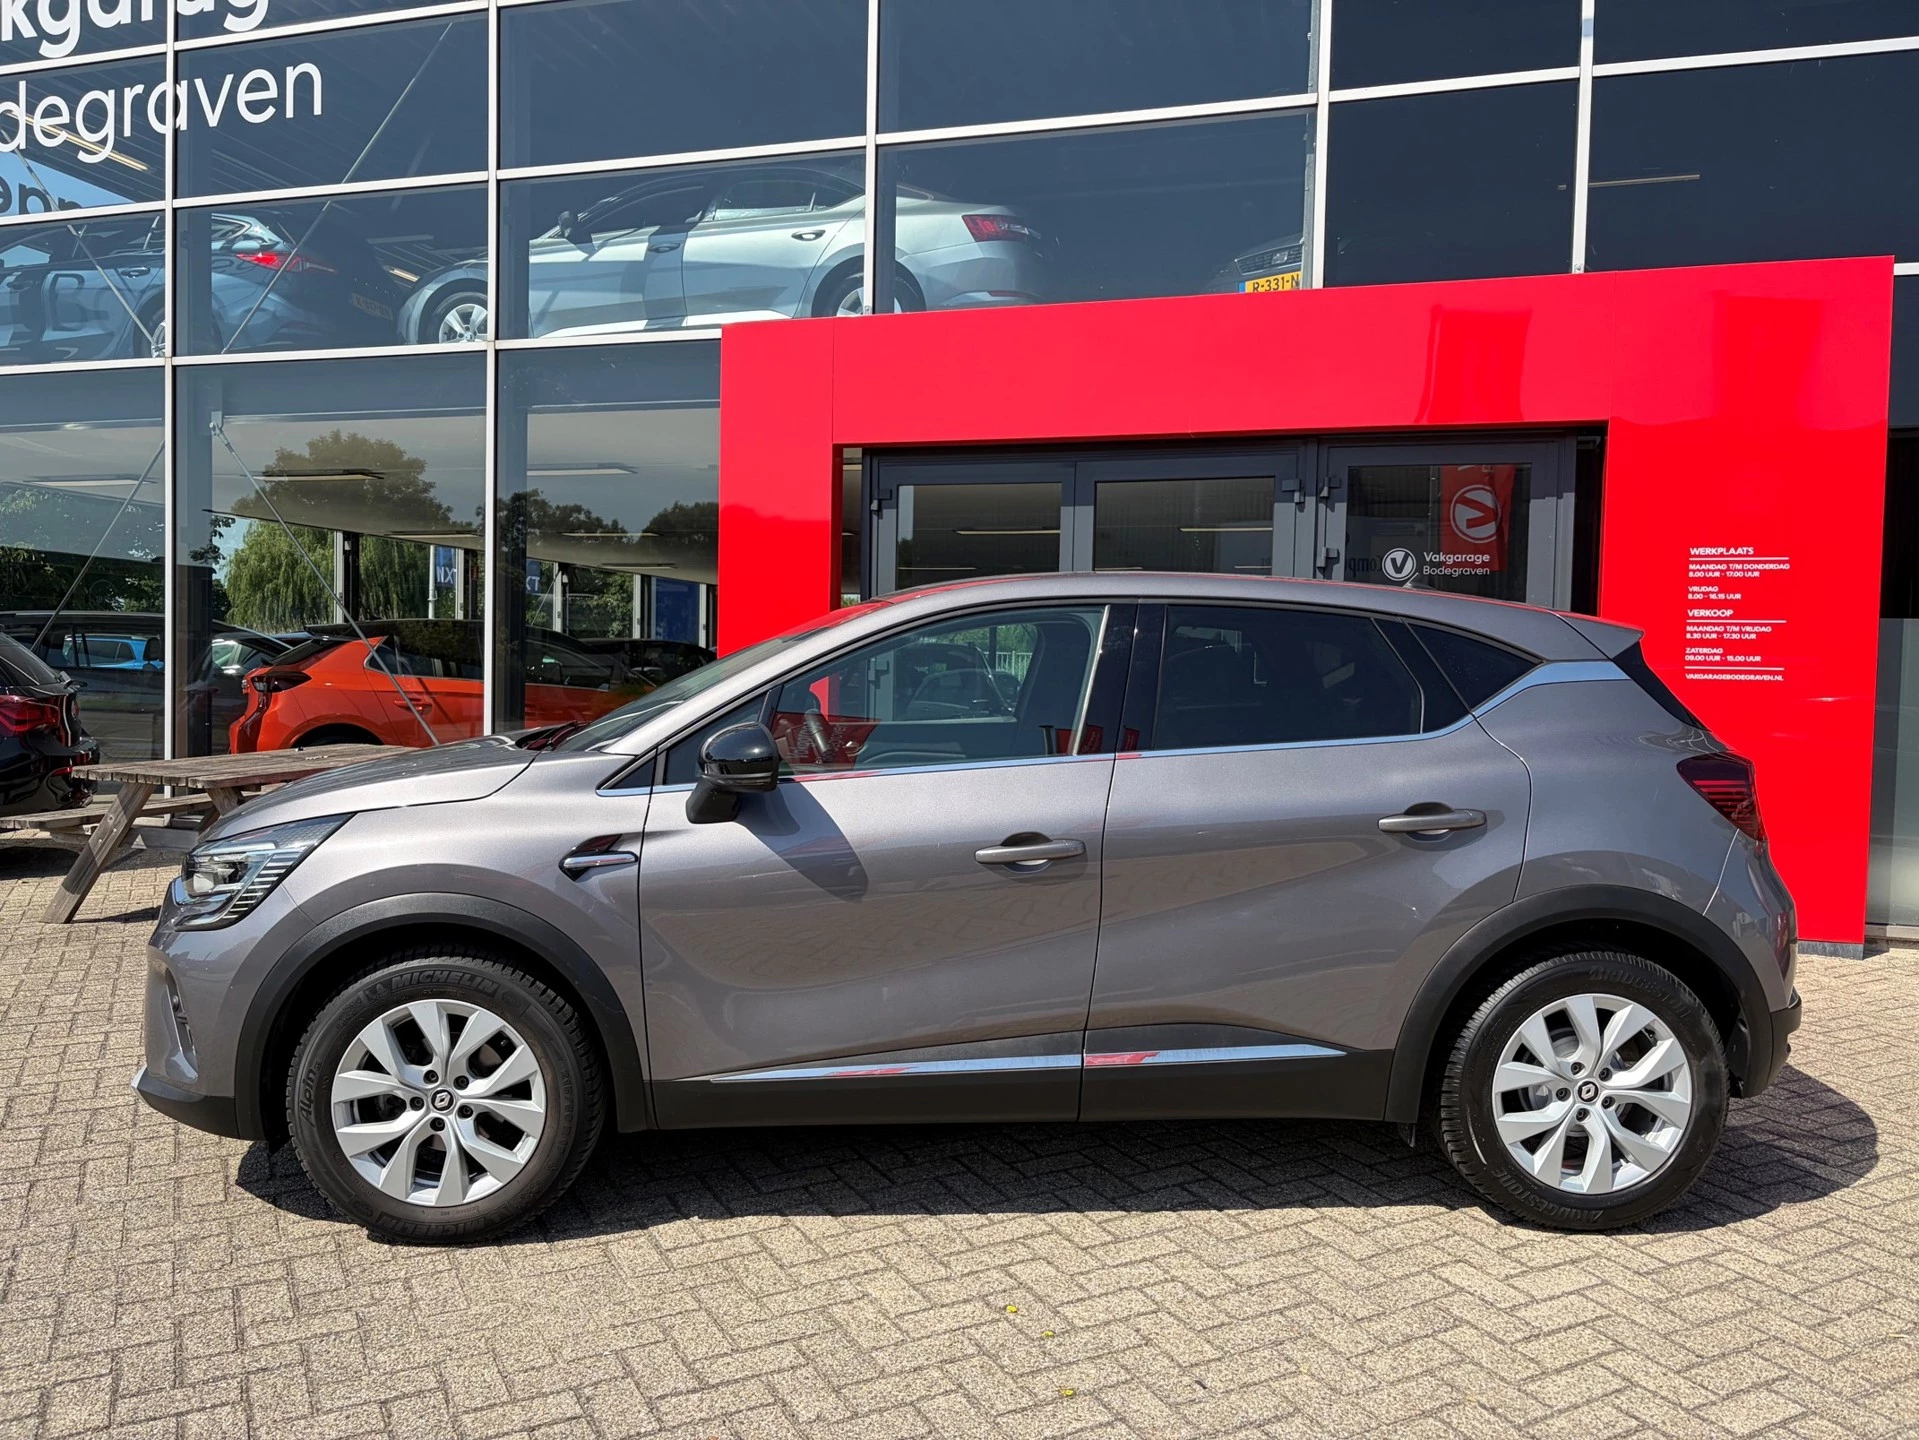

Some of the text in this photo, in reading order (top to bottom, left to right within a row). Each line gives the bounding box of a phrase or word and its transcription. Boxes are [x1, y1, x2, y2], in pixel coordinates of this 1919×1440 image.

[0, 62, 323, 163] degraven
[1423, 551, 1490, 564] Vakgarage
[1689, 546, 1754, 556] WERKPLAATS
[1423, 565, 1490, 578] Bodegraven
[1687, 609, 1733, 618] VERKOOP
[1685, 673, 1784, 681] VAKGARAGEBODEGRAVEN.NL
[391, 969, 499, 994] MICHELIN
